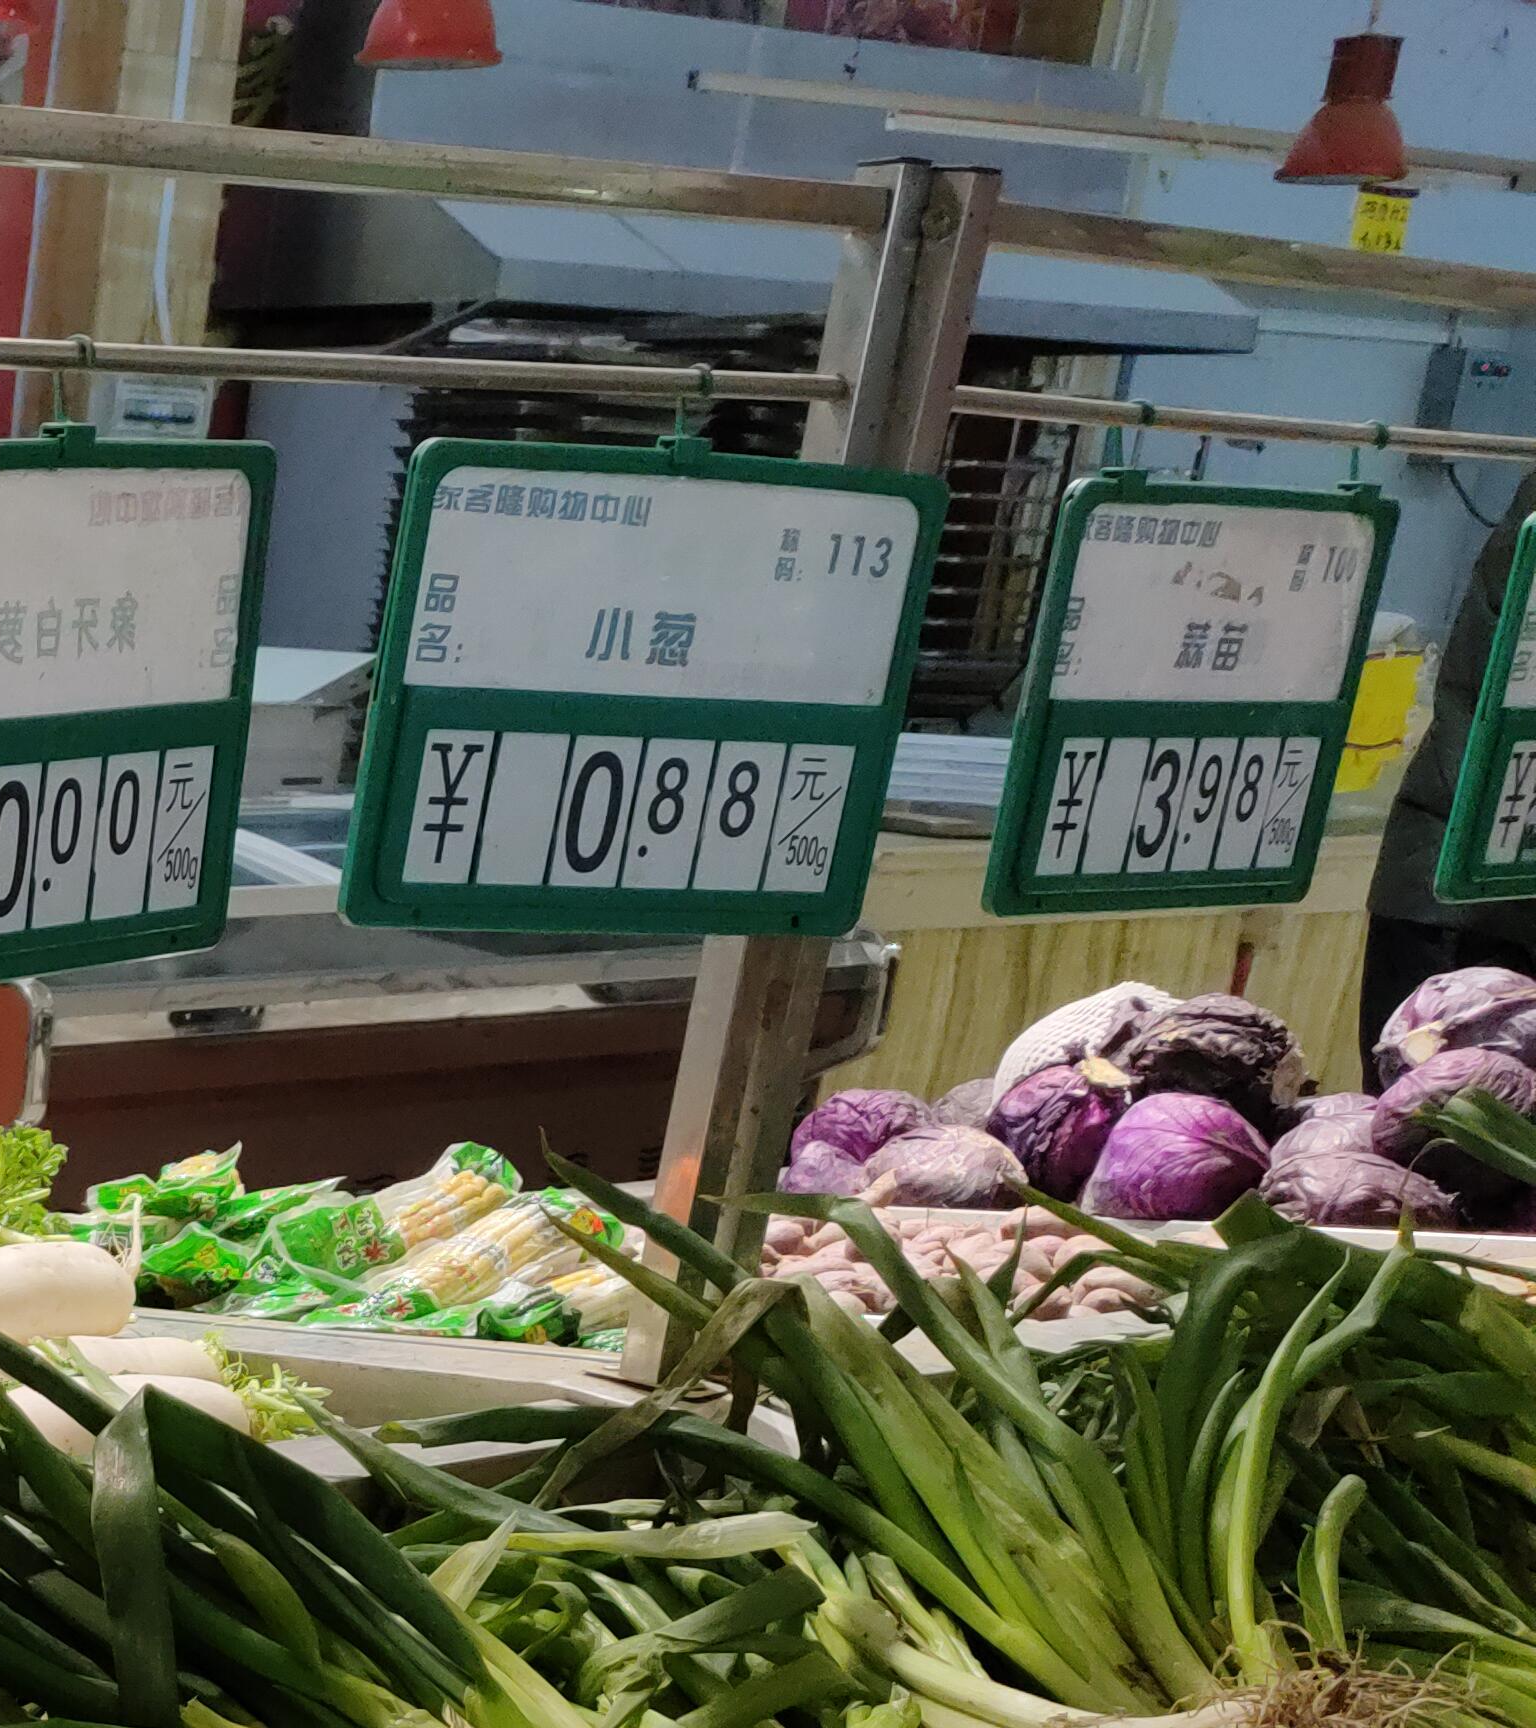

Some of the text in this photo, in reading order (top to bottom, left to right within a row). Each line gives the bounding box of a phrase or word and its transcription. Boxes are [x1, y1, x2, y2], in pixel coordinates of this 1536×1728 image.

[828, 533, 893, 579] 113
[585, 607, 698, 668] 小葱
[423, 743, 484, 864] ¥
[1051, 751, 1096, 859] ¥
